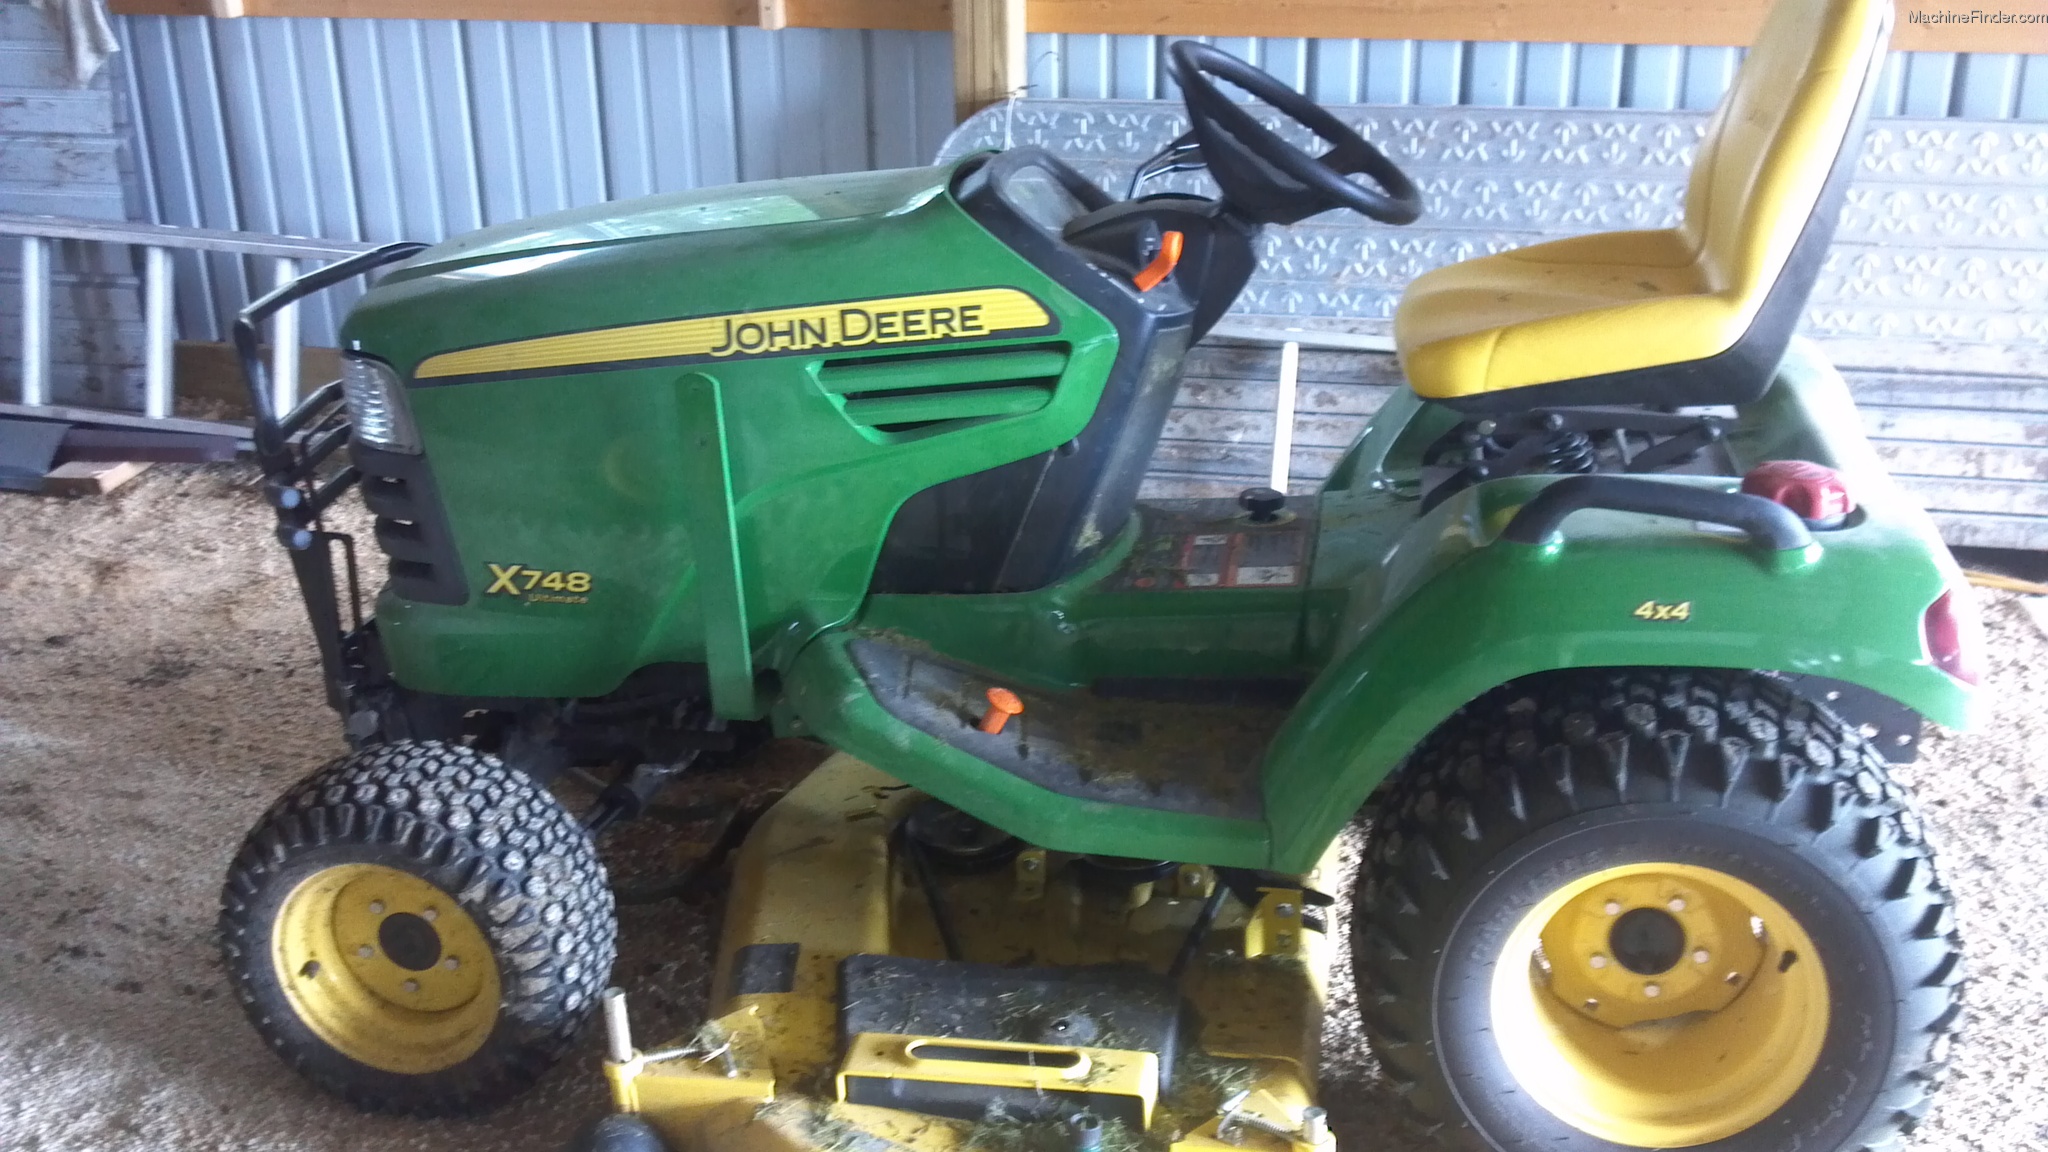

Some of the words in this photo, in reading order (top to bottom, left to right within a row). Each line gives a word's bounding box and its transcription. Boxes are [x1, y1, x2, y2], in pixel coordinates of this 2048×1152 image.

[710, 317, 828, 354] JOHN
[839, 304, 984, 342] DEERE
[486, 563, 592, 595] X748
[1633, 600, 1691, 620] 4x4
